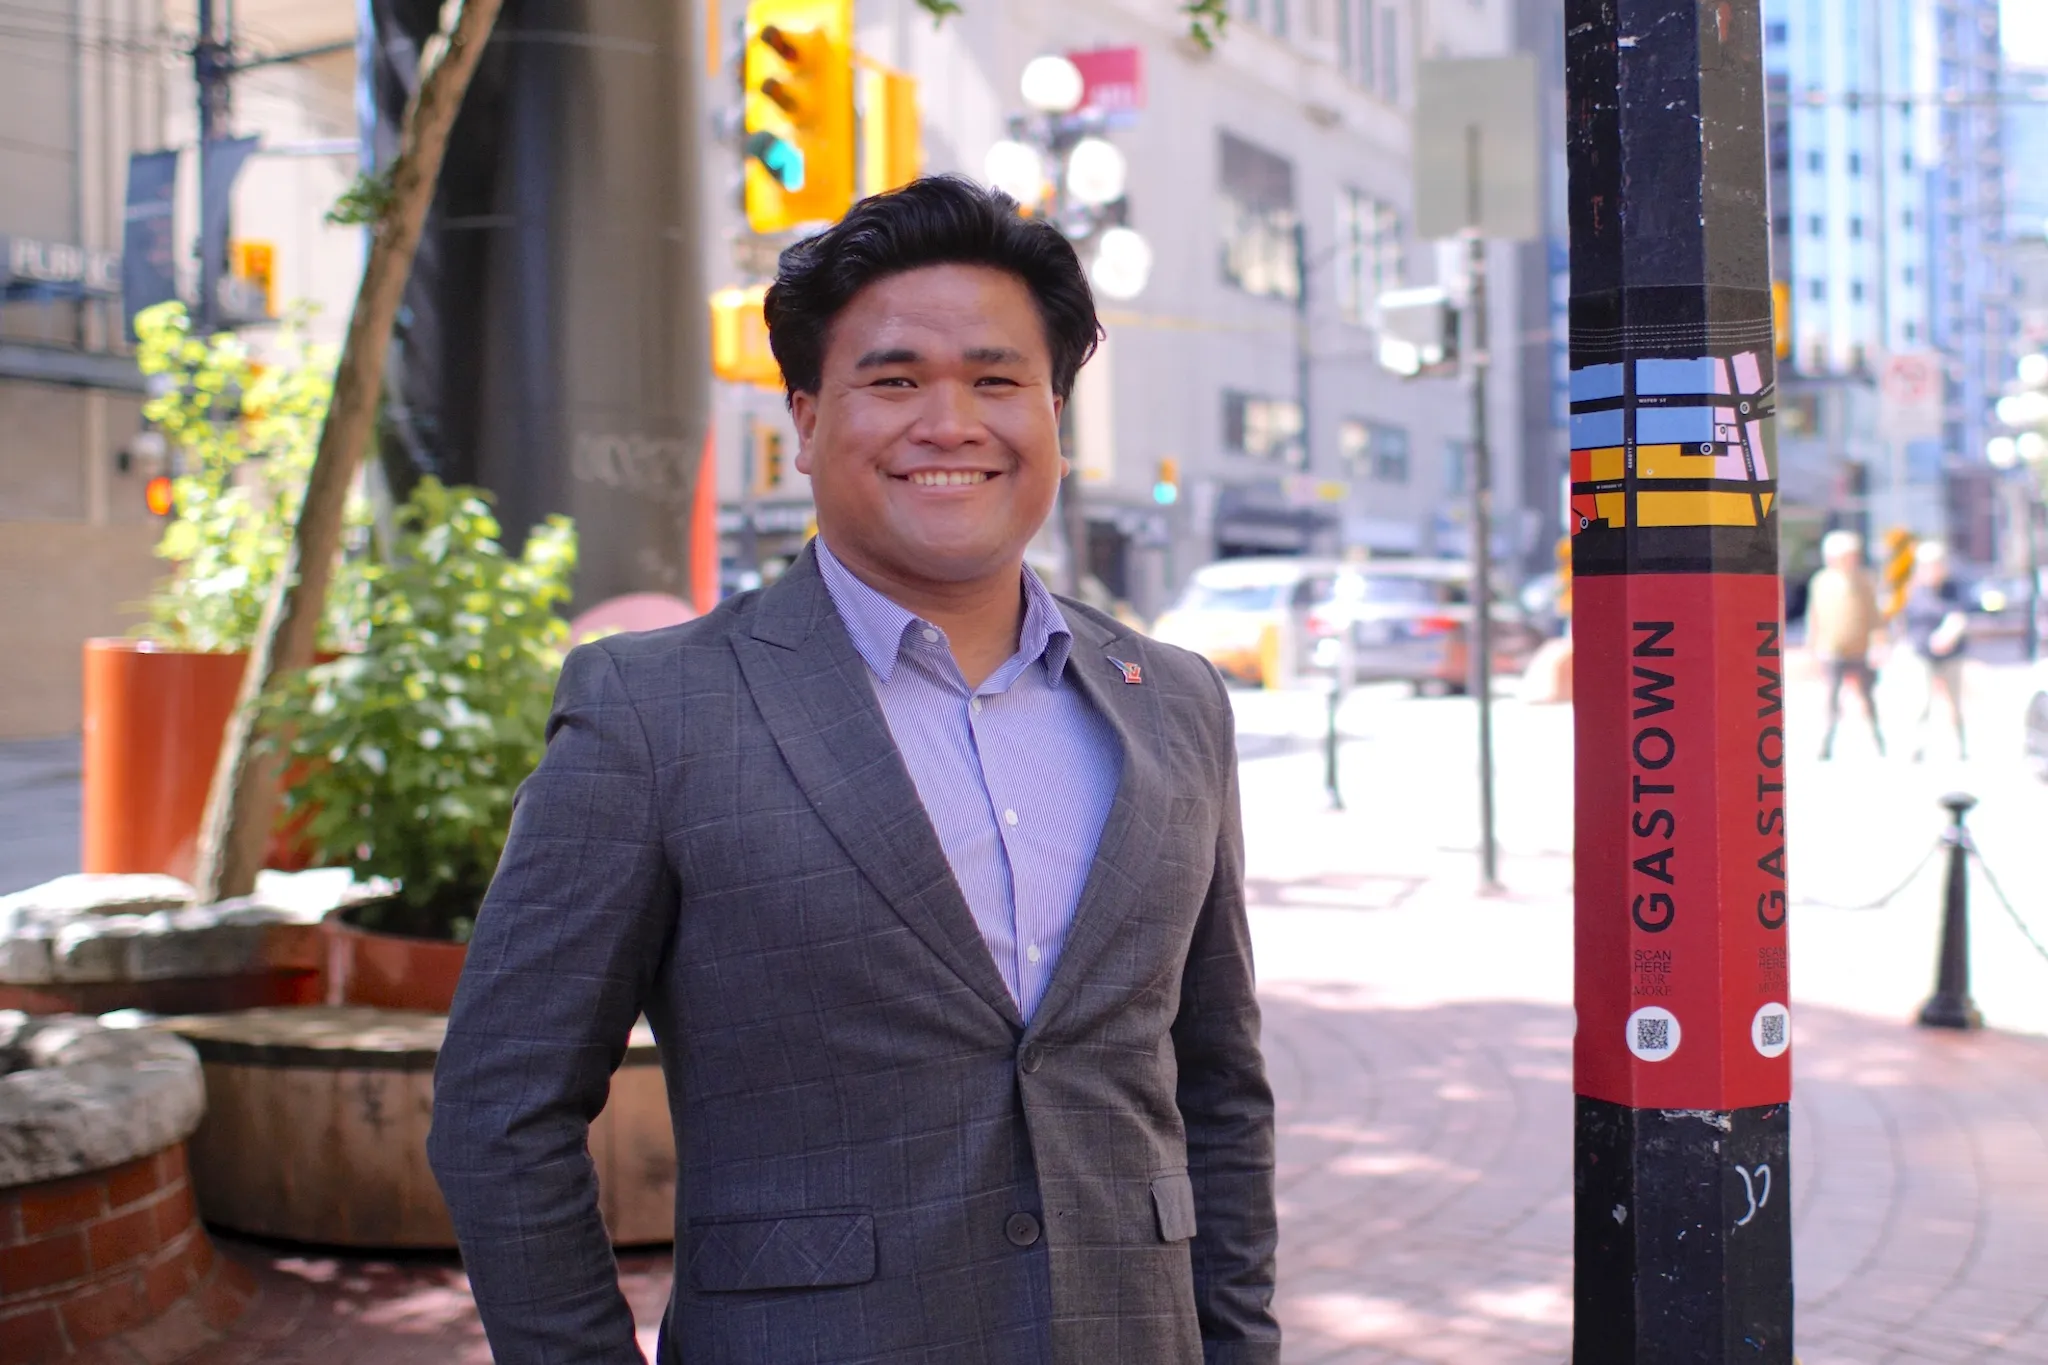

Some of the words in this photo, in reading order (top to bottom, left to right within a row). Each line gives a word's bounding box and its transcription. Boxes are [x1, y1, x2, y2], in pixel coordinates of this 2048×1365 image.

[1633, 621, 1675, 933] GASTOWN
[1756, 621, 1786, 930] GASTOWN
[1634, 949, 1672, 961] SCAN
[1634, 961, 1672, 973] HERE
[1641, 973, 1666, 984] FOR
[1633, 985, 1672, 997] MORE
